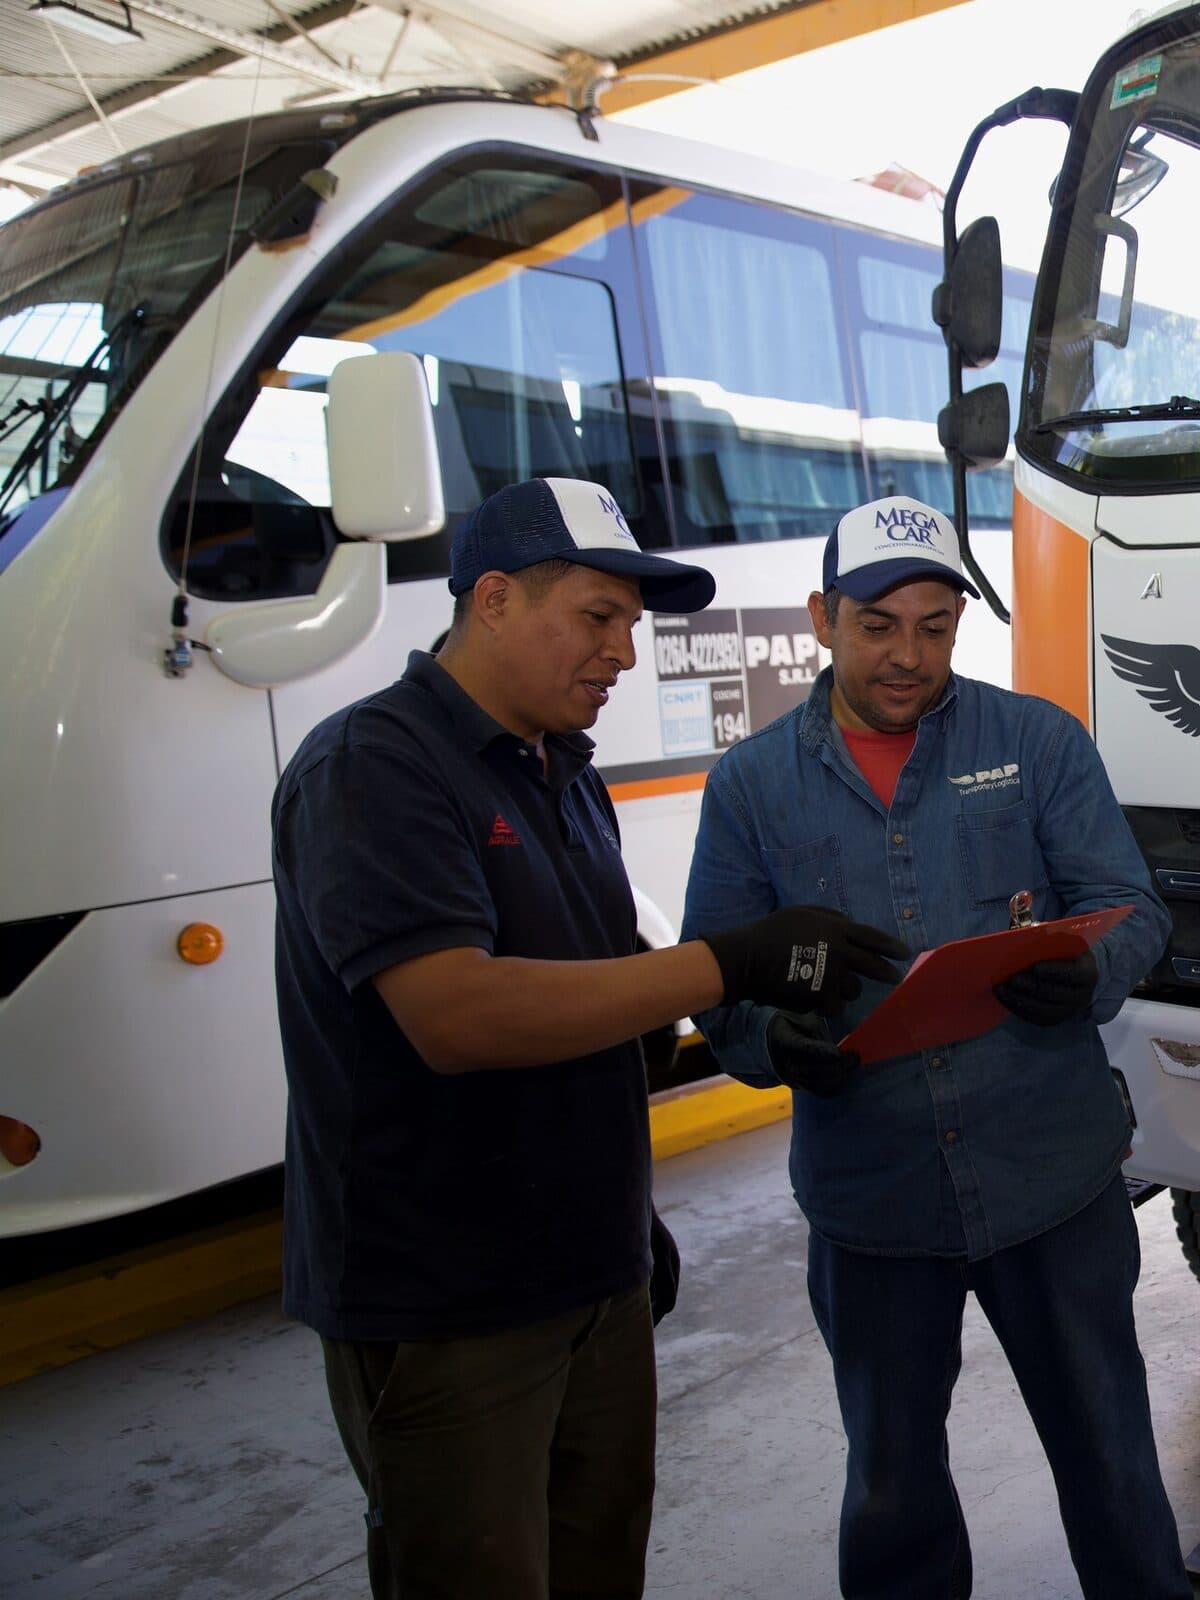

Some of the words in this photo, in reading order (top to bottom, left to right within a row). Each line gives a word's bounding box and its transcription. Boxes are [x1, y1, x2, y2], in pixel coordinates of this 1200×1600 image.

[874, 507, 942, 536] MEGA
[886, 523, 936, 547] CAR
[744, 633, 817, 669] PAP
[714, 711, 746, 742] 194
[976, 763, 1019, 783] PAP
